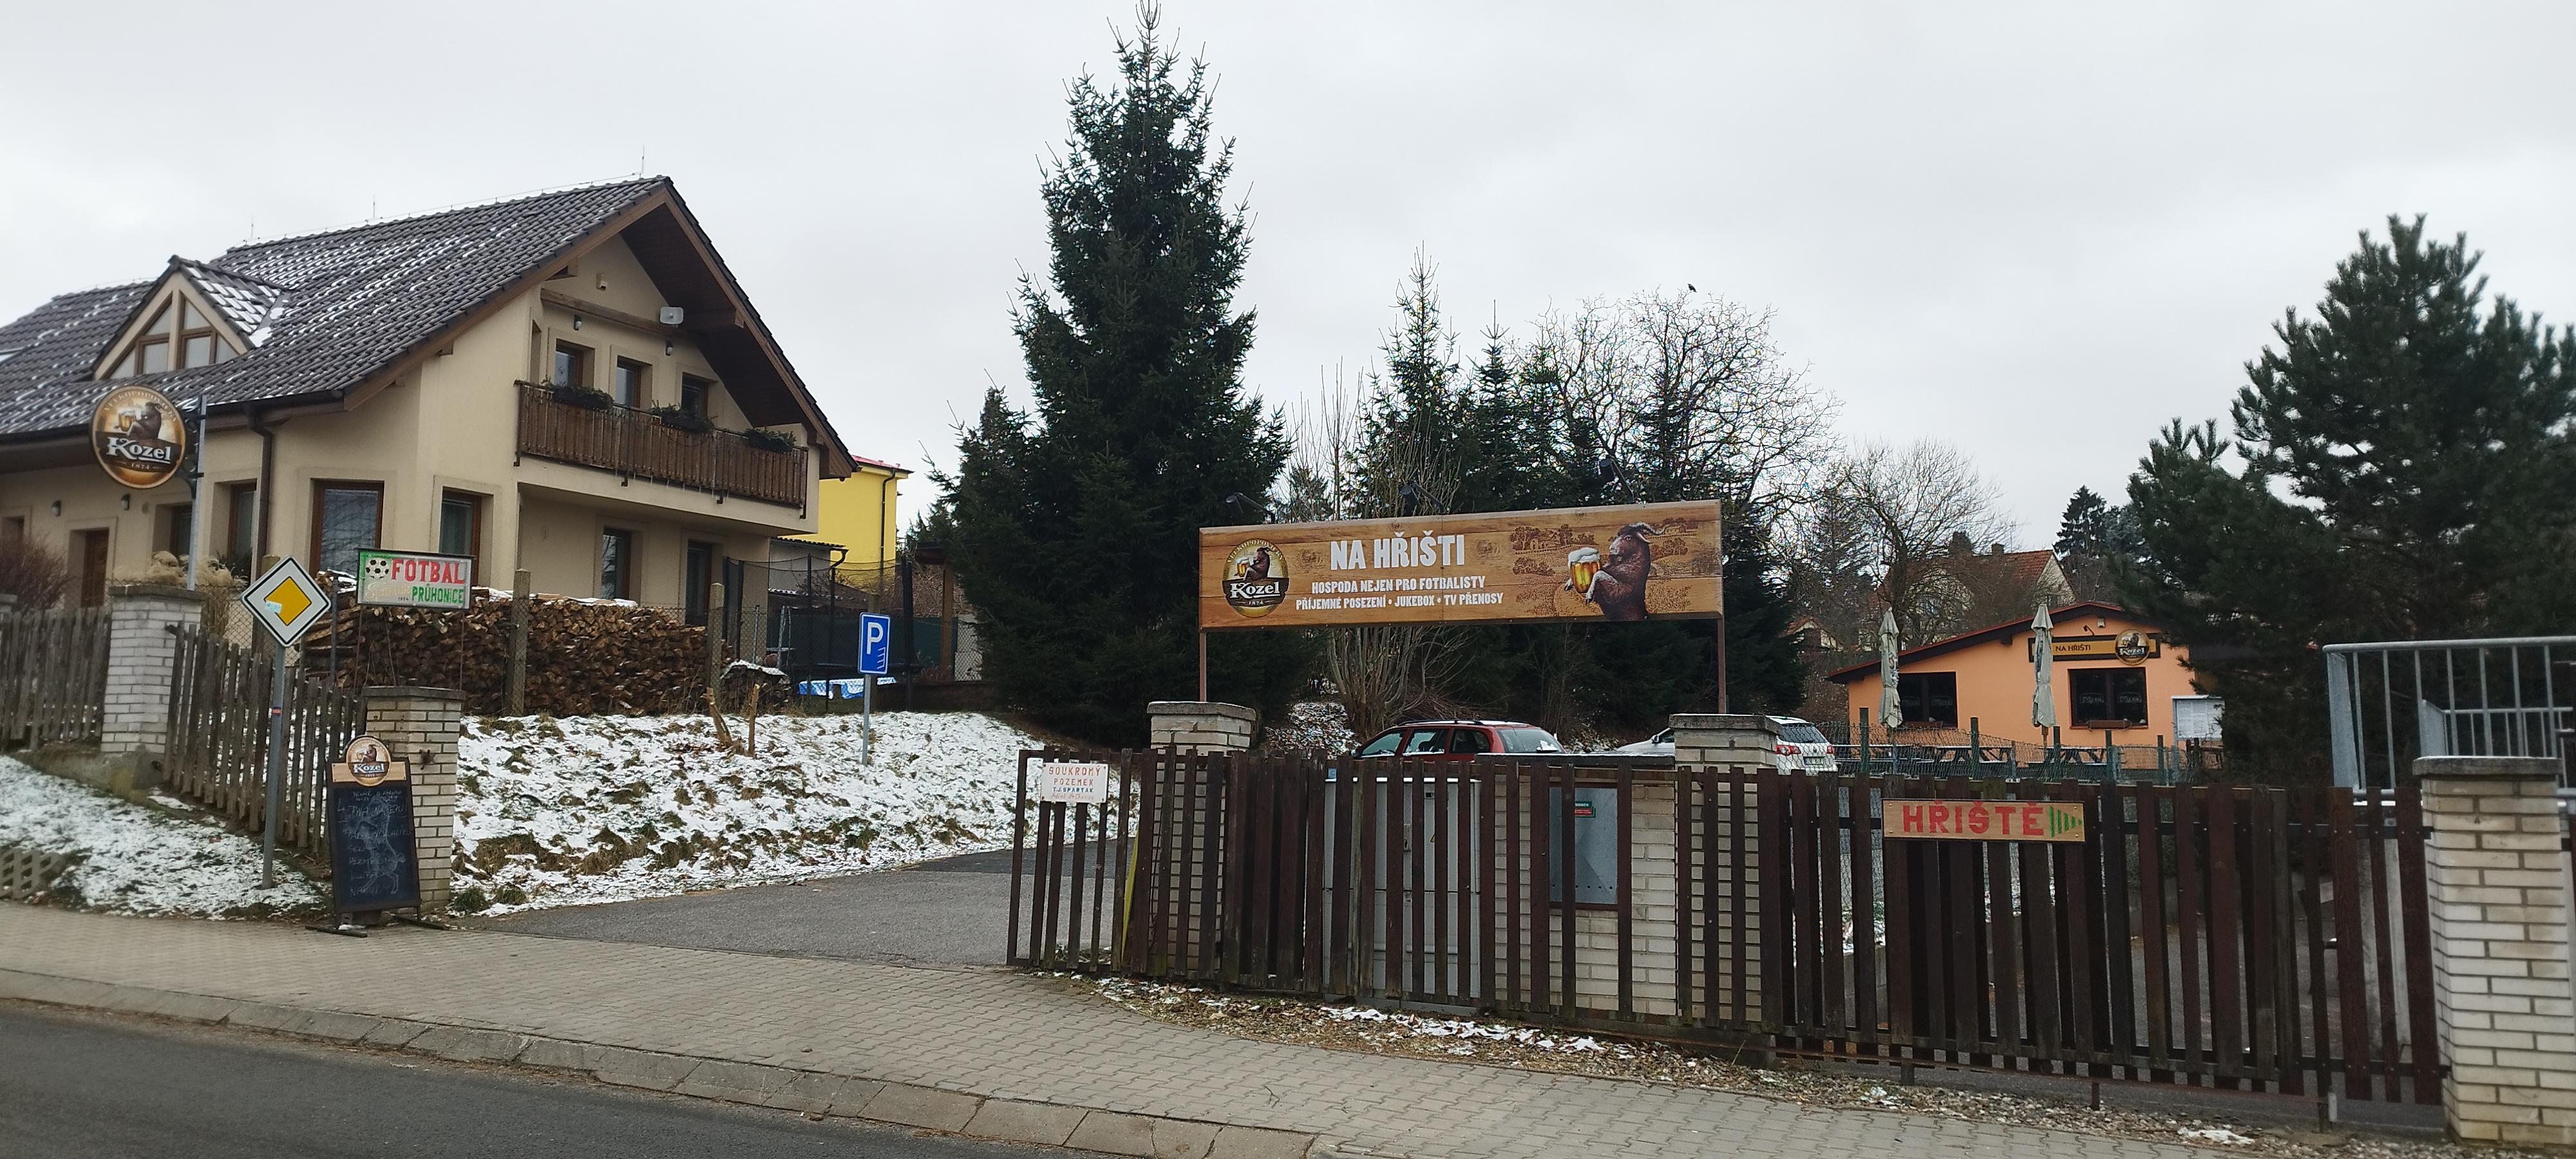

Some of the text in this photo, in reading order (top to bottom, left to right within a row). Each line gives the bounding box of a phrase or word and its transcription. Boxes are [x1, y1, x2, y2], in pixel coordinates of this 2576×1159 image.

[106, 437, 171, 464] Kozel
[1331, 530, 1464, 570] NA HŘIŠTI
[391, 558, 465, 584] FOTBAL
[412, 583, 464, 603] PRŮHONICE
[1230, 581, 1280, 599] Kozel
[1312, 576, 1486, 594] HOSPODA NEJEN PRO FOTBALISTY
[1296, 592, 1504, 610] PŘÍJEMNÉ POSEZENÍ JUKEBOX TV PŘENOSY
[866, 622, 884, 655] P
[354, 763, 385, 773] Kozel
[1048, 766, 1101, 777] SOUKROMÝ
[1902, 800, 2044, 836] HŘIŠTĚ
